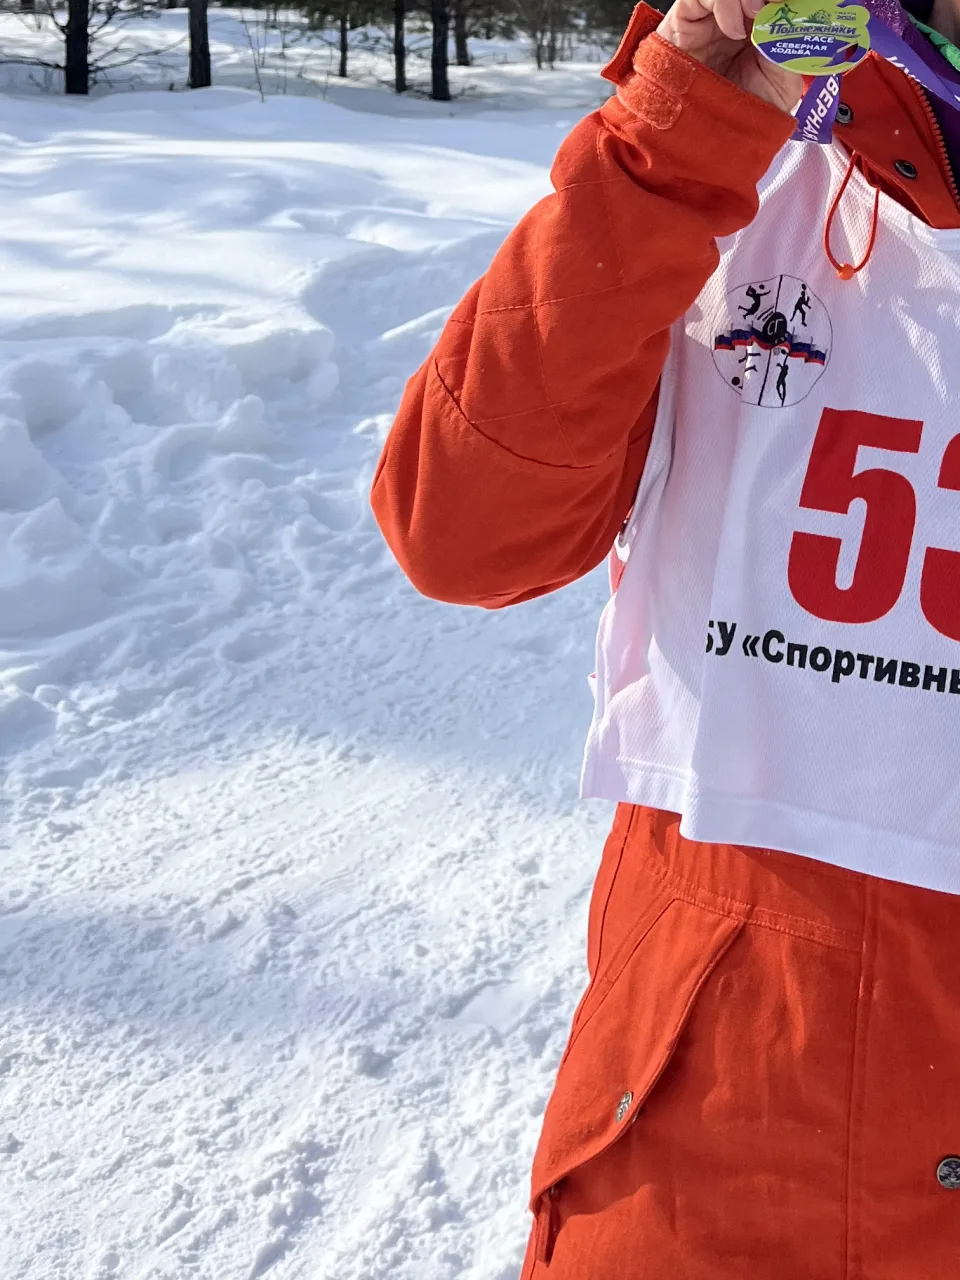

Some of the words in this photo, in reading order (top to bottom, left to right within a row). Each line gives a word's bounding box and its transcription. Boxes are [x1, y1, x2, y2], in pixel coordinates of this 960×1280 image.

[769, 23, 857, 35] Подснежники
[803, 35, 834, 43] RACE
[770, 47, 811, 55] ХОДЬБА
[776, 42, 827, 51] СЕВЕРНАЯ
[803, 74, 839, 141] ВЕРНАЯ
